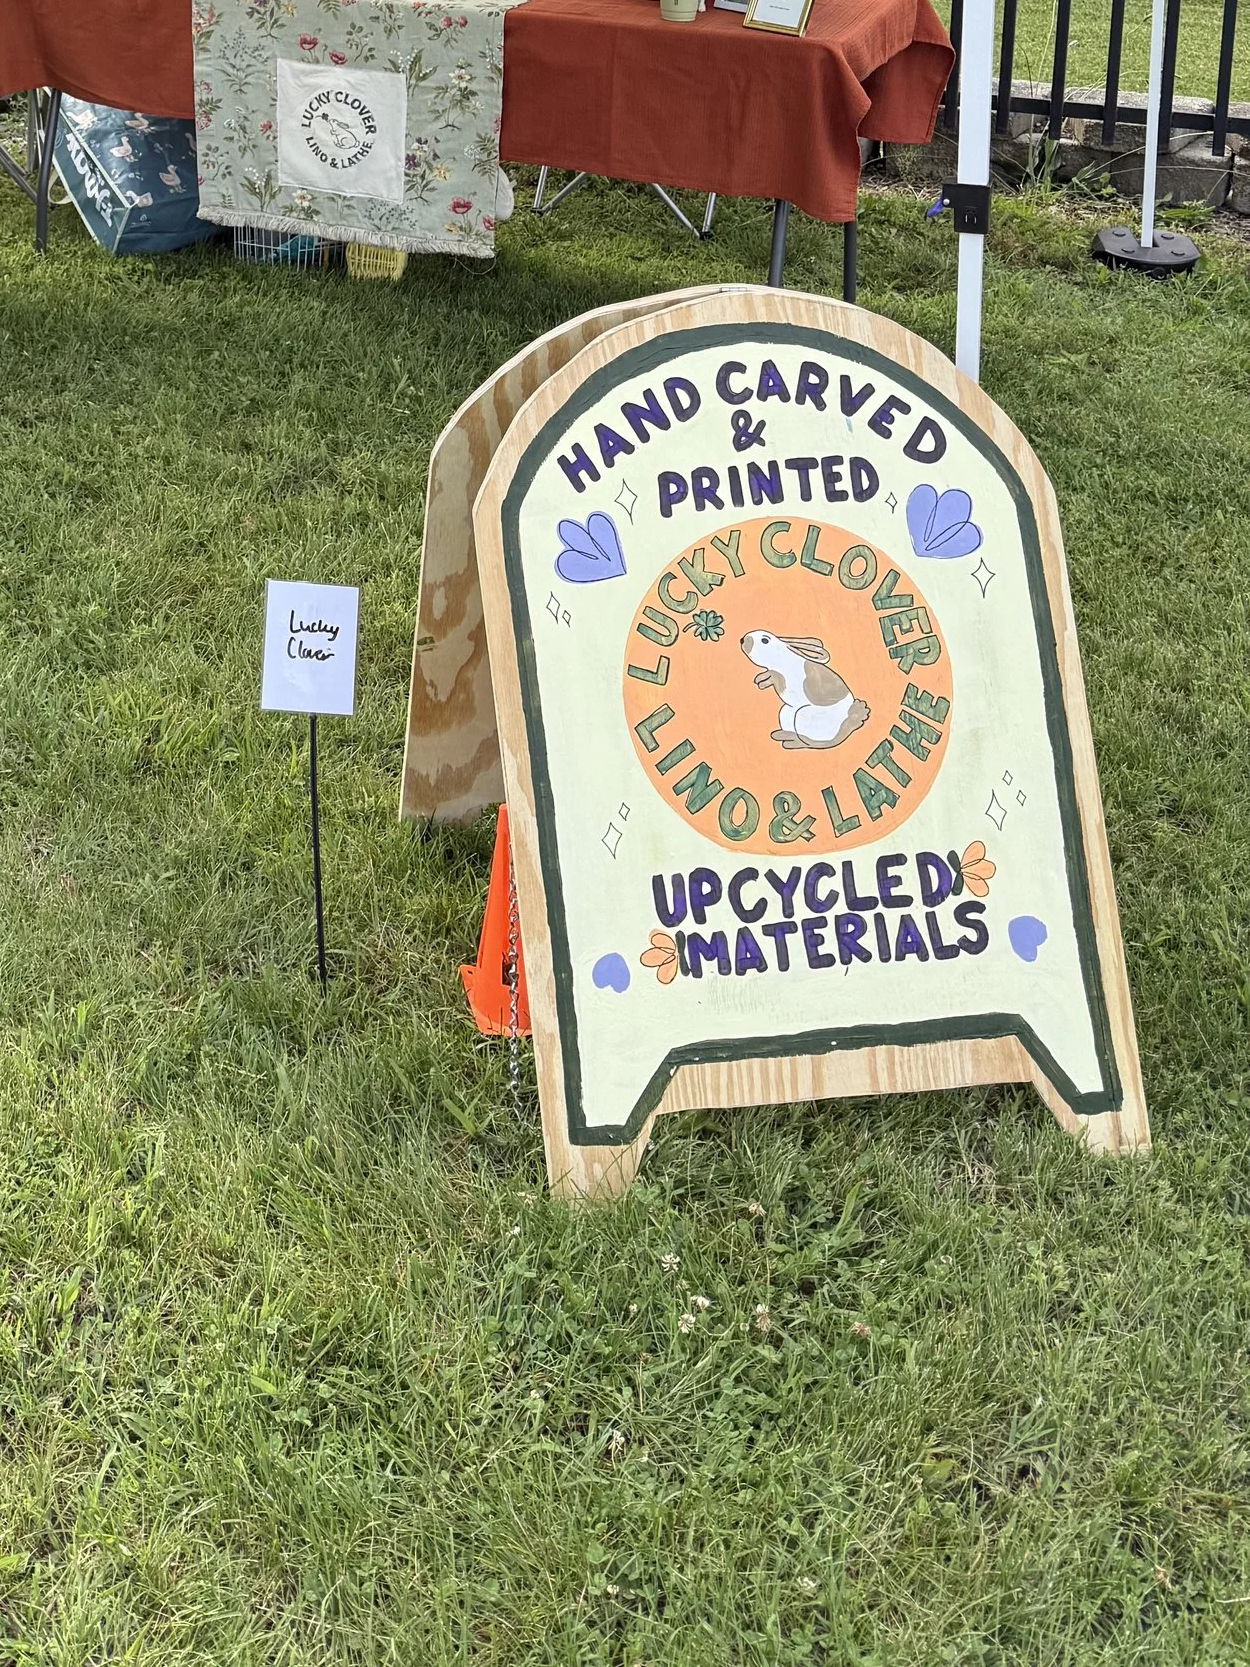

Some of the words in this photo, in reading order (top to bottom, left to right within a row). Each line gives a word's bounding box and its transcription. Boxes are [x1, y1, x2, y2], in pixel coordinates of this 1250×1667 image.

[301, 90, 331, 128] LUCKY
[334, 90, 377, 135] CLOVER
[305, 136, 328, 163] LINO
[330, 157, 339, 169] &
[341, 140, 373, 169] LATHE
[557, 375, 704, 494] HAND
[714, 359, 948, 465] CARVED
[731, 410, 766, 451] &
[657, 455, 881, 519] PRINTED
[289, 610, 340, 642] Lucky
[628, 528, 745, 686] LUCKY
[760, 520, 942, 676] CLOVER
[634, 702, 761, 841] LINO
[768, 790, 817, 843] &
[821, 682, 951, 838] LATHE
[651, 852, 951, 927] UPCYCLED
[687, 899, 990, 977] MATERIALS
